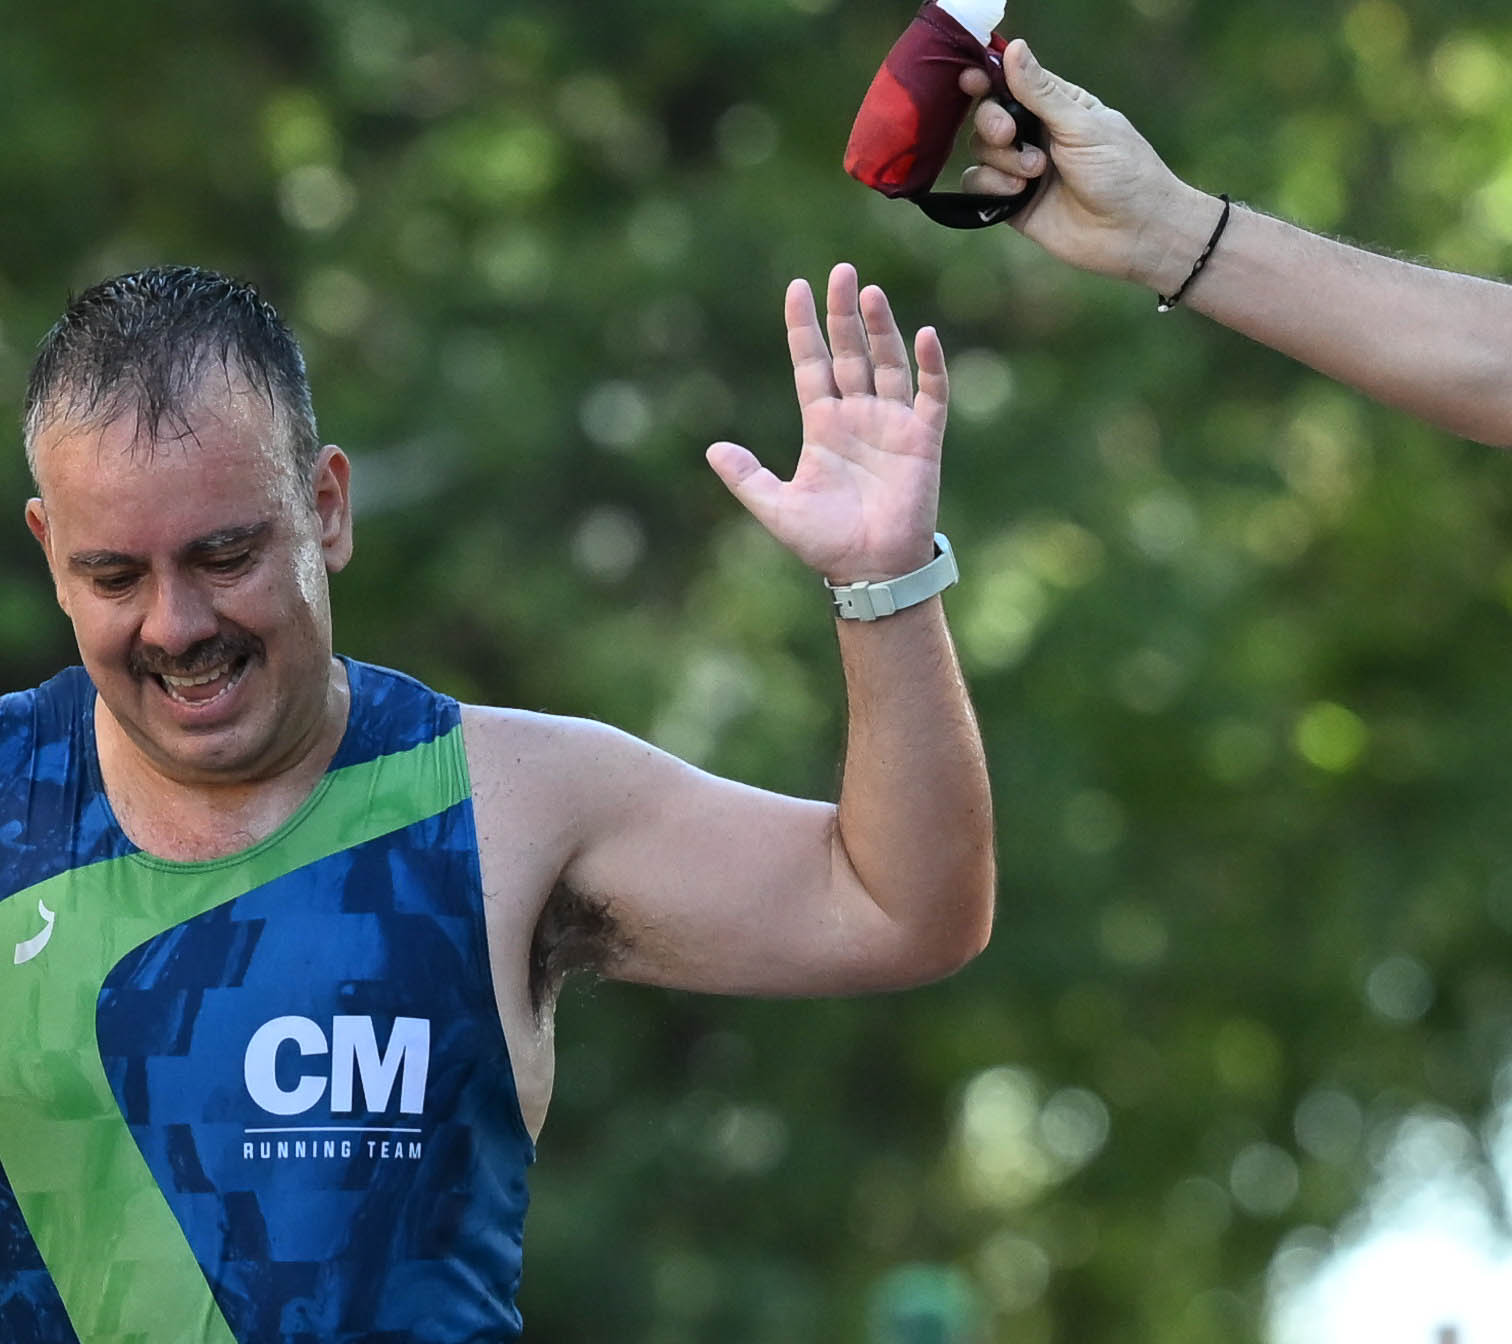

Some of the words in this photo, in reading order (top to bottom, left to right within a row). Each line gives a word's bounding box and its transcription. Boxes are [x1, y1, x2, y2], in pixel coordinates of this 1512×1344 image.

[244, 1015, 431, 1116] CM
[243, 1140, 352, 1160] RUNNING
[367, 1140, 423, 1160] TEAM
